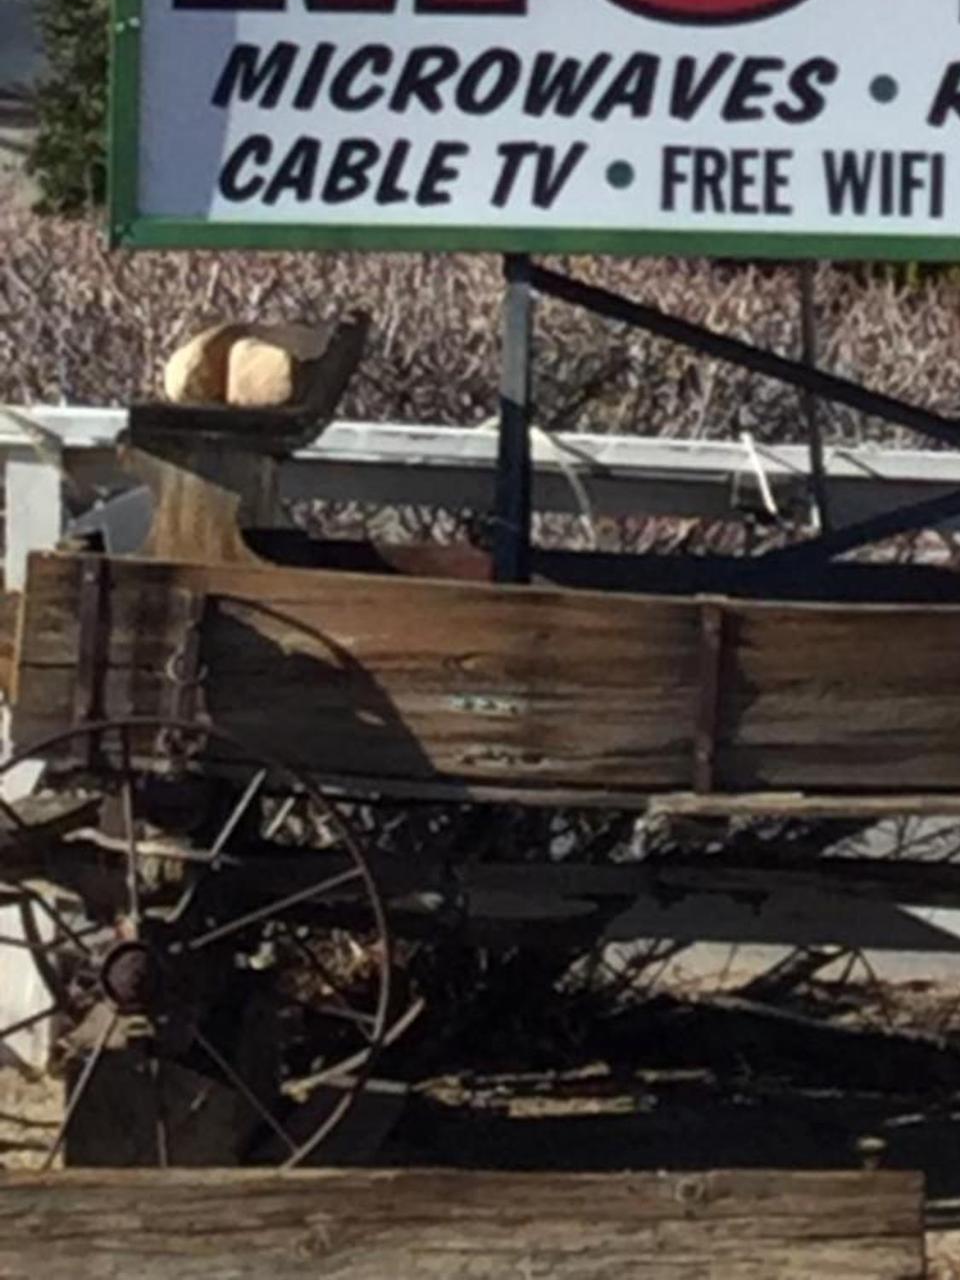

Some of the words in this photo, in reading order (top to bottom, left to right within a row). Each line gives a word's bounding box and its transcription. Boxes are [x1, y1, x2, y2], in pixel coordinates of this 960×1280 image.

[211, 42, 838, 122] MICROWAVES
[218, 135, 468, 207] CABLE
[490, 142, 587, 209] TV
[660, 147, 794, 217] FREE
[824, 150, 944, 220] WIFI
